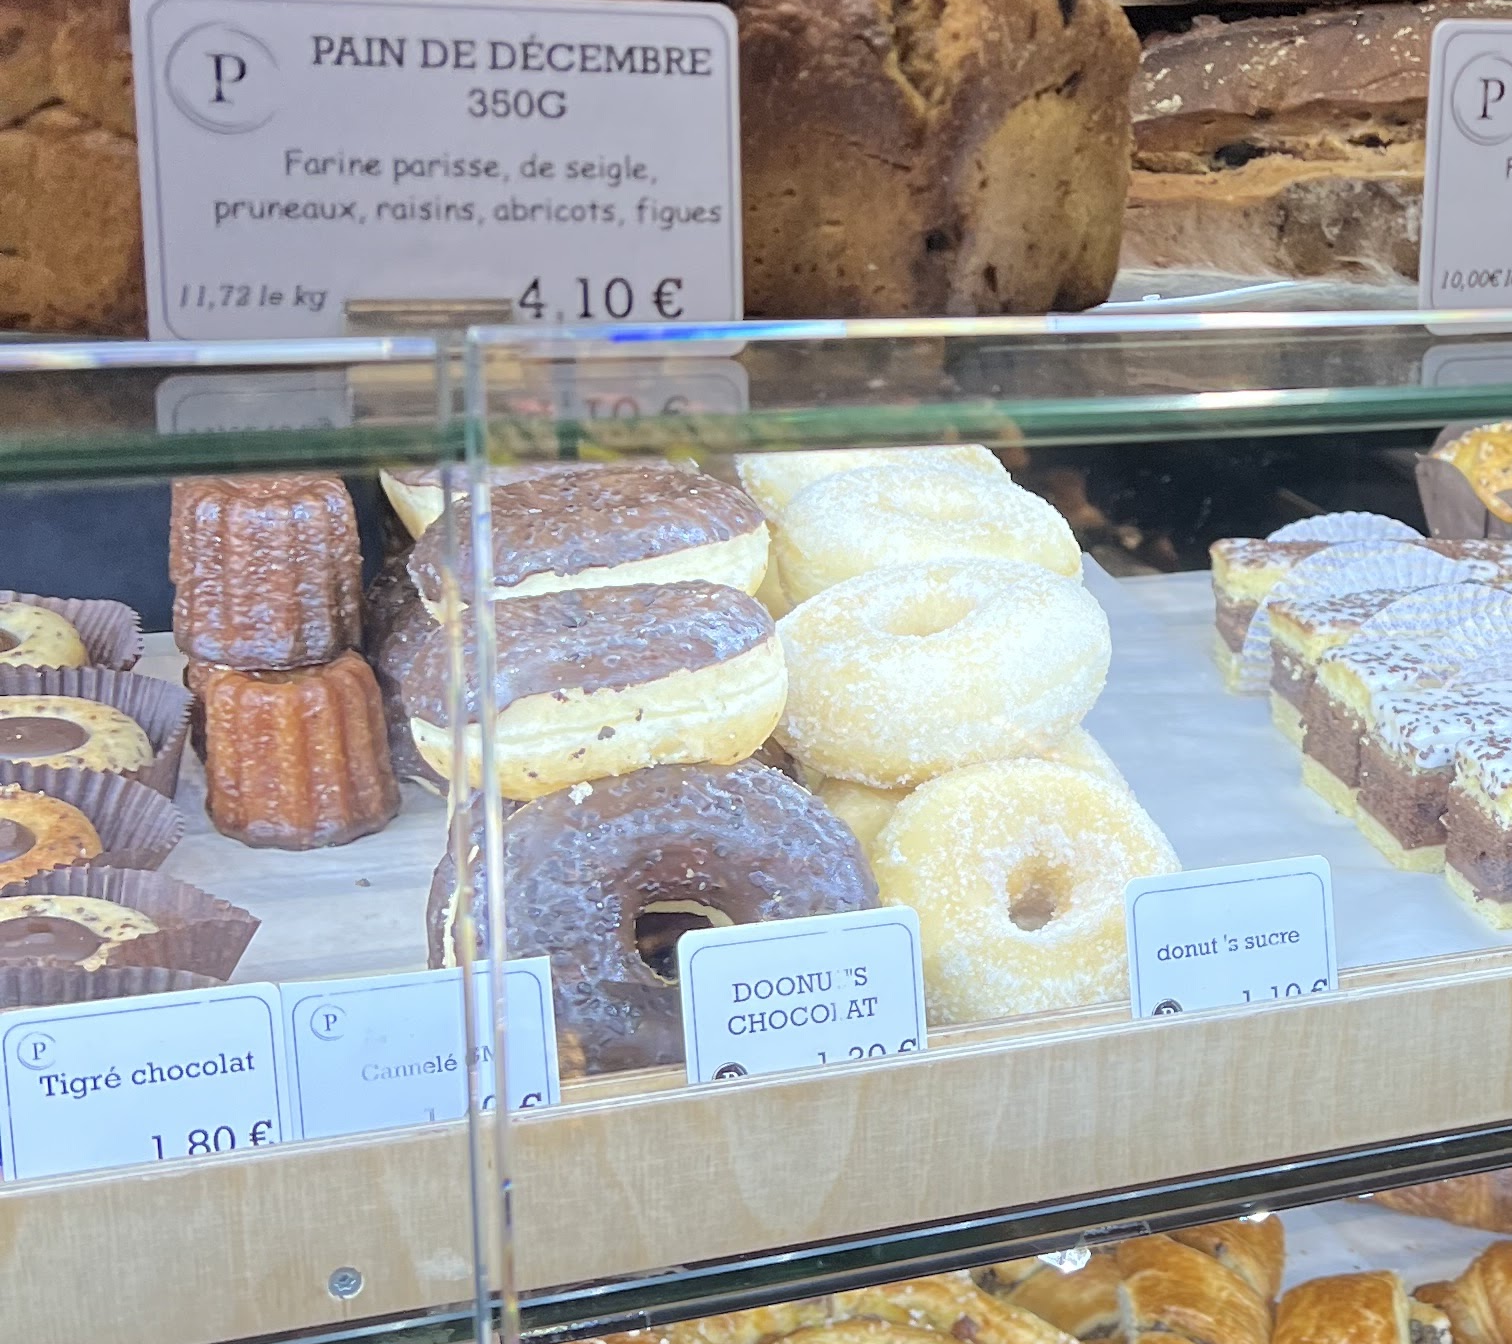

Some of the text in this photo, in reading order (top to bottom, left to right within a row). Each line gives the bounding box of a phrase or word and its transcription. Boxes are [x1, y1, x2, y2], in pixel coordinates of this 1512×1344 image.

[312, 33, 712, 77] PAIN DE DÉCEMBRE
[207, 53, 247, 104] P
[468, 89, 568, 119] 350G
[1478, 78, 1505, 120] P
[285, 150, 657, 185] Farine parisse, de seigle,
[214, 198, 722, 229] pruneaux, raisins, abricots, figues
[259, 284, 283, 306] le
[294, 284, 327, 312] kg
[518, 277, 685, 322] 4,10 €
[1157, 938, 1218, 961] donut
[1245, 931, 1300, 949] sucre
[323, 1014, 337, 1032] P
[32, 1042, 46, 1060] P
[39, 1051, 255, 1099] Tigré chocolat
[361, 1054, 457, 1082] Cannelé
